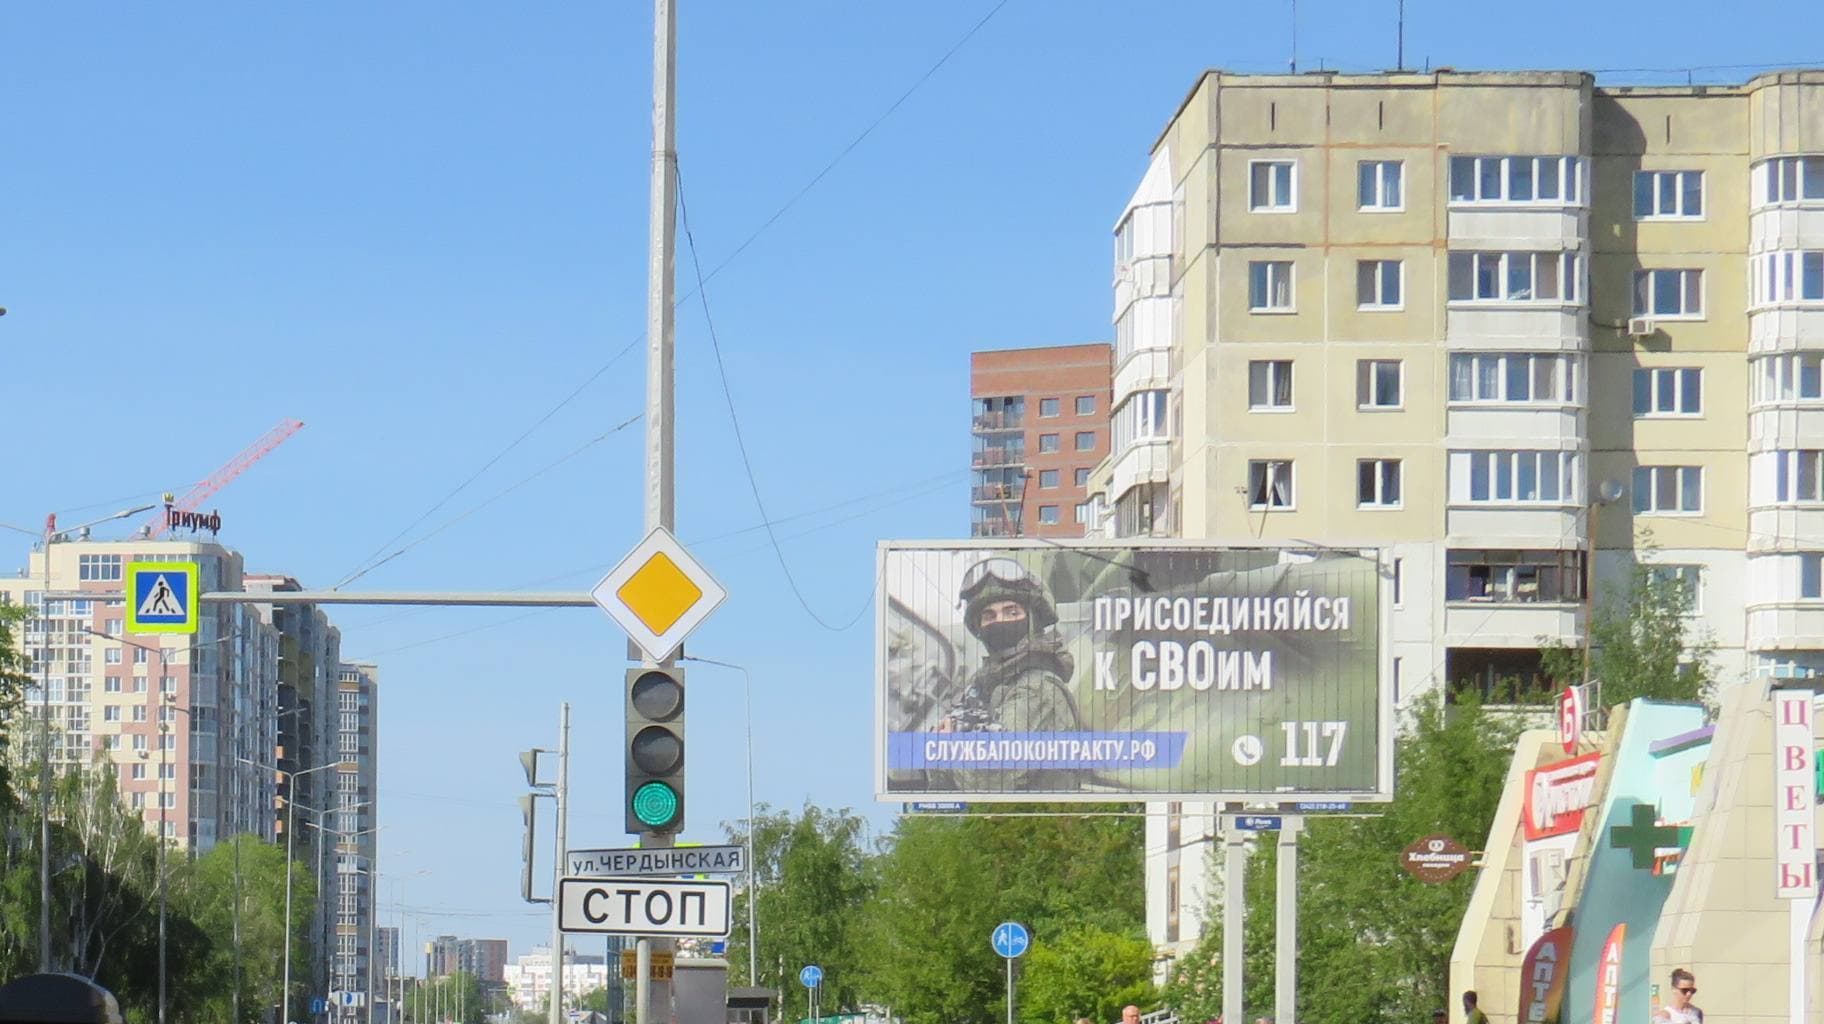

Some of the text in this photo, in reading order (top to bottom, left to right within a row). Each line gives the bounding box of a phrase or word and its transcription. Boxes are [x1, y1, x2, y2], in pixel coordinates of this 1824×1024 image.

[164, 504, 221, 536] Триумф
[1094, 590, 1350, 634] ПРИСОЕДИНЯЙСЯ
[926, 739, 1156, 761] СЛУЖБАПОКОНТРАКТУ.РФ
[1280, 721, 1347, 767] 117
[1780, 700, 1813, 889] ЦВЕТЫ
[583, 888, 706, 926] СТОП
